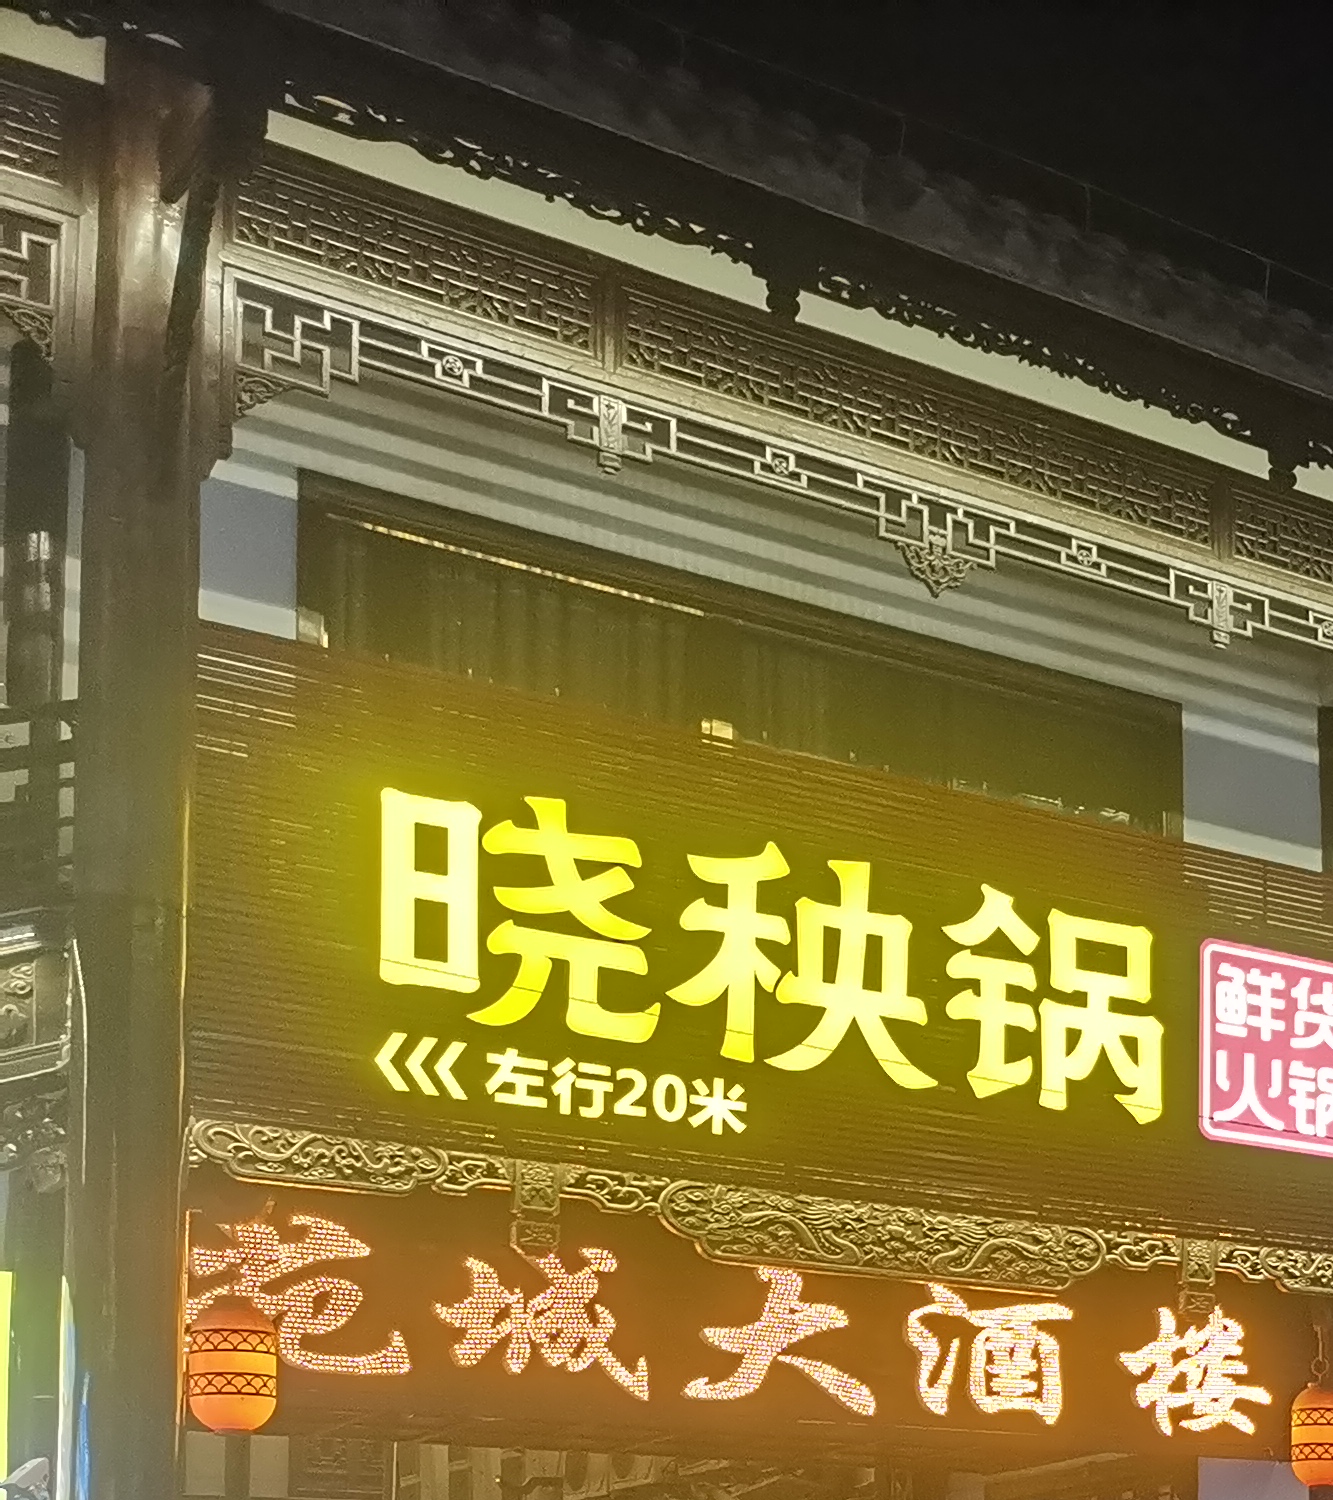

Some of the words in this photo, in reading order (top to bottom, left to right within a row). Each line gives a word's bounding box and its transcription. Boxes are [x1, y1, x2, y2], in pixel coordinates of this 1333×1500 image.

[378, 785, 1167, 1125] 晓秧锅
[483, 1045, 749, 1137] 左行20米
[184, 1213, 1272, 1437] 苑城大酒楼
